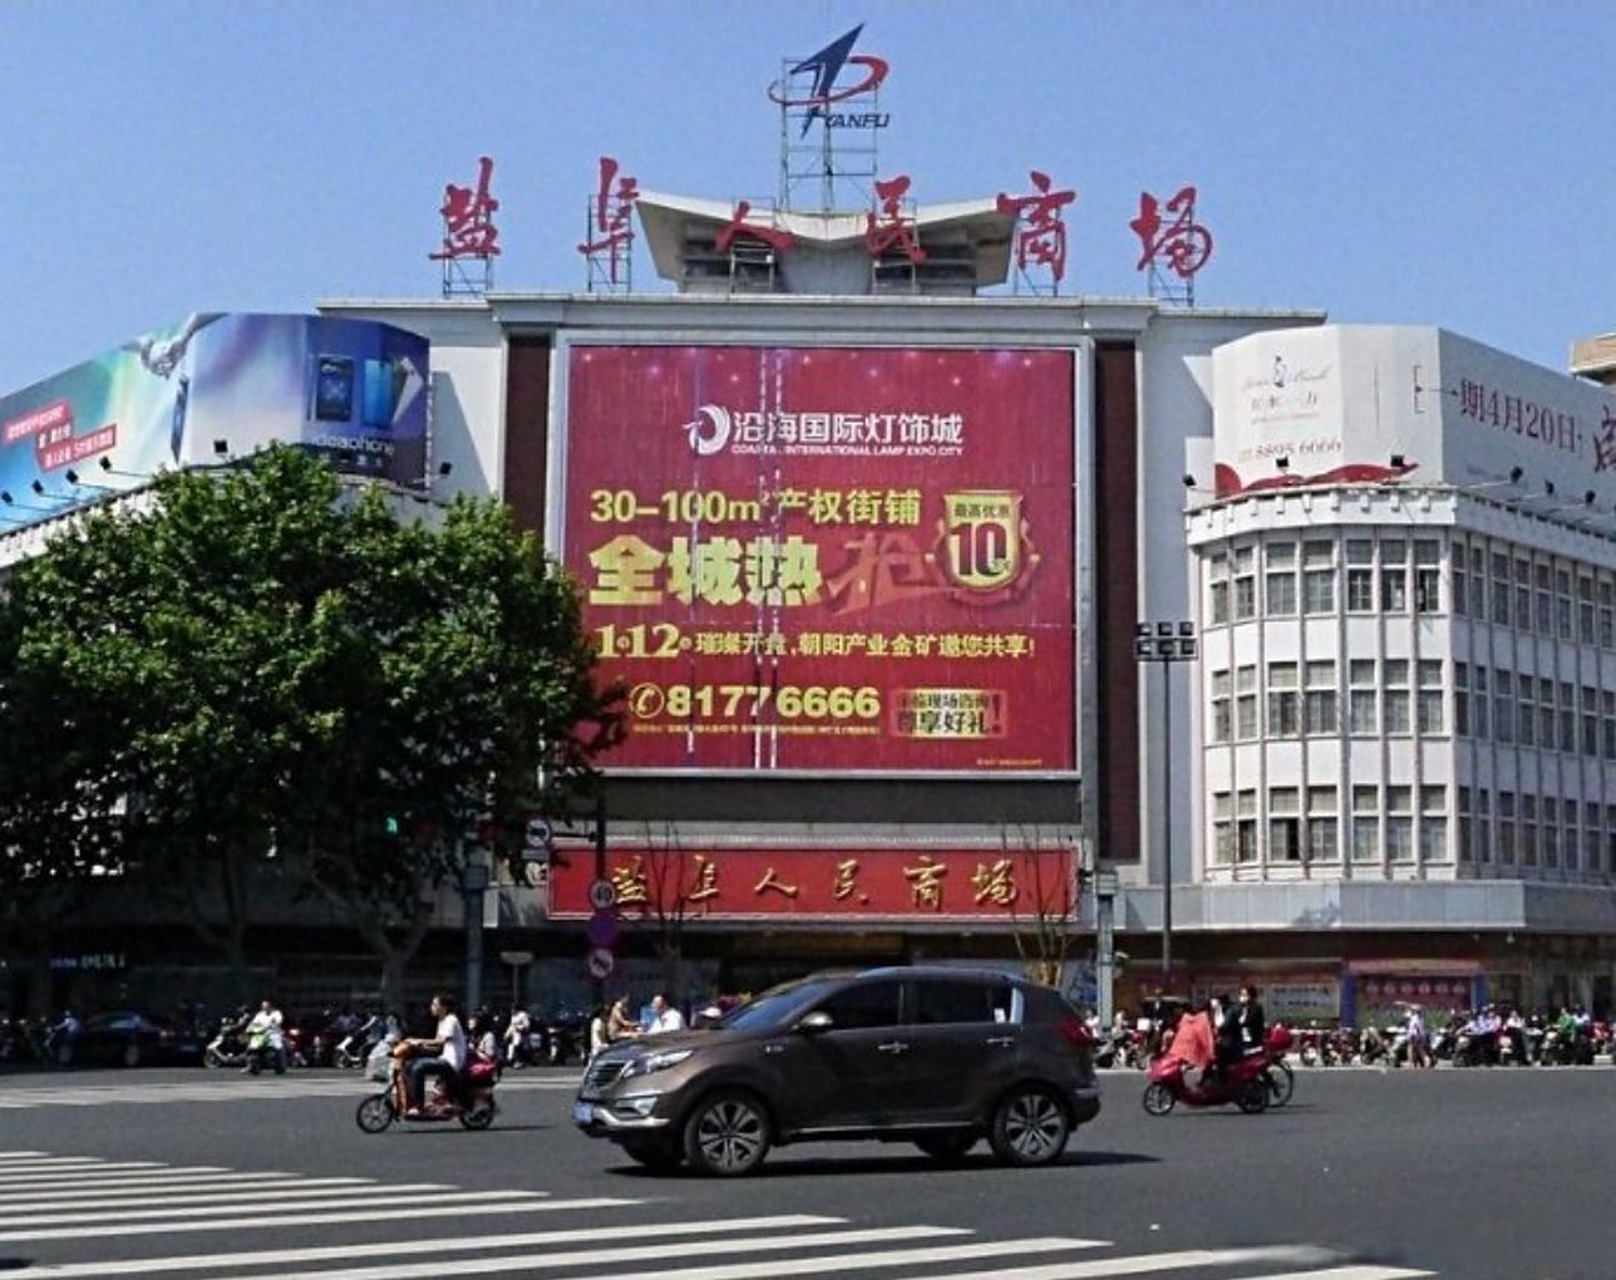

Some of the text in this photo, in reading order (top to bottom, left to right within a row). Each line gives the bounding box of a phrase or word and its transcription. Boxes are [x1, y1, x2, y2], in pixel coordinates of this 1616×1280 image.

[430, 157, 1213, 283] 盐阜人民商场
[733, 412, 964, 444] 沿海国际灯饰城
[949, 522, 1007, 576] 10
[611, 855, 1019, 912] 盐阜人民商场
